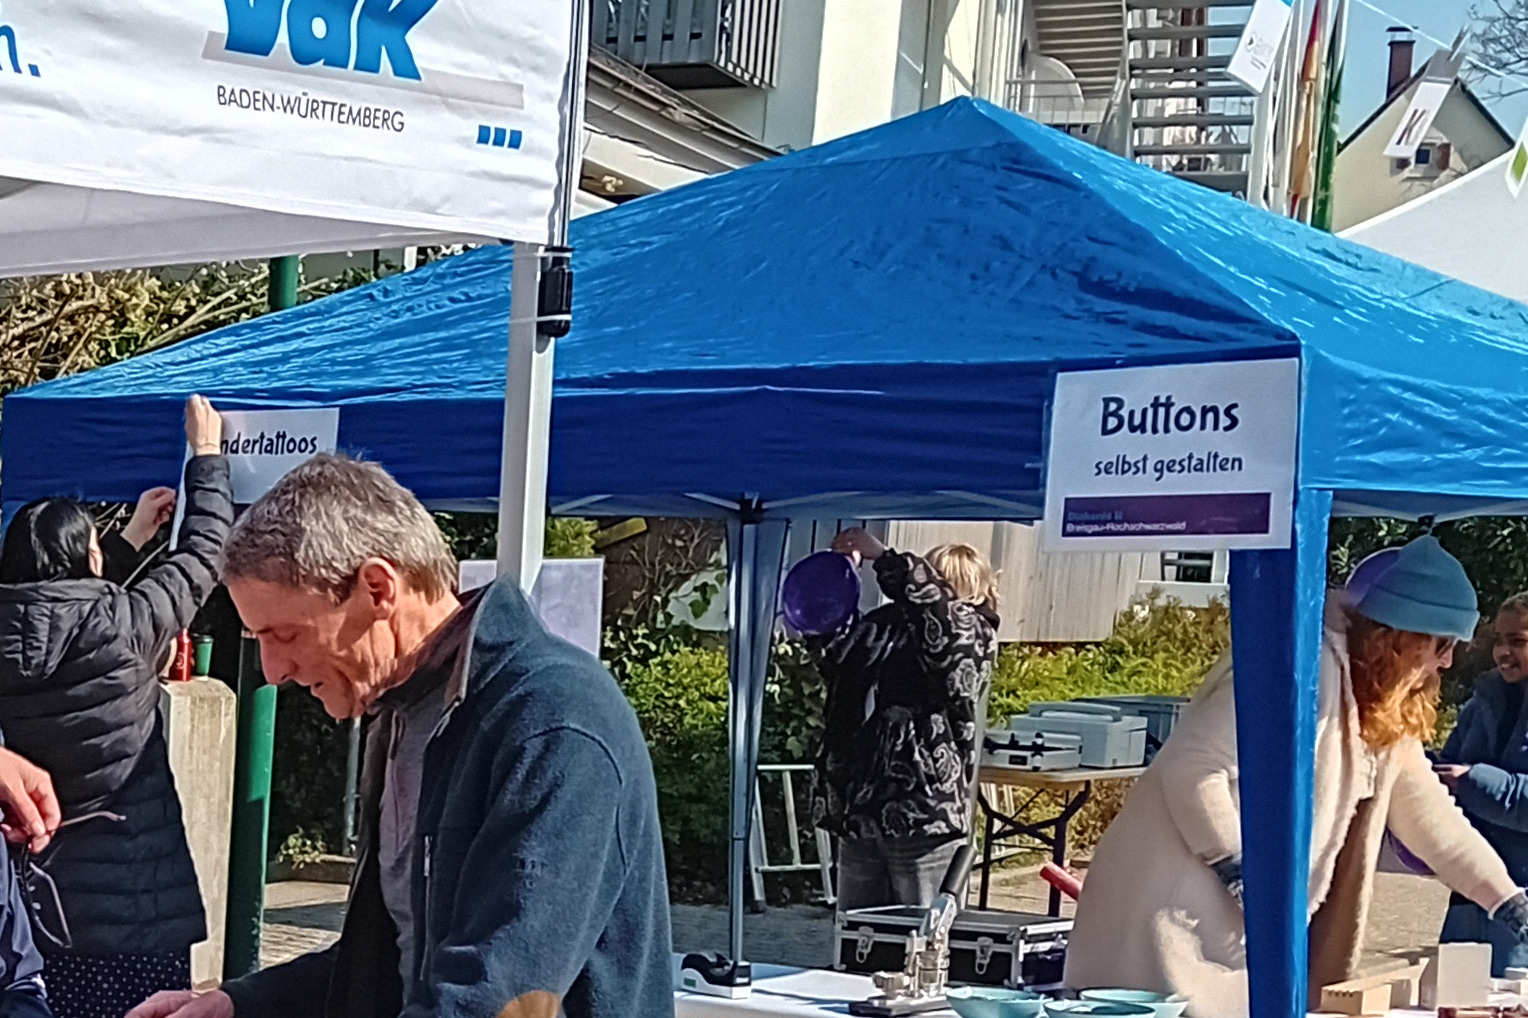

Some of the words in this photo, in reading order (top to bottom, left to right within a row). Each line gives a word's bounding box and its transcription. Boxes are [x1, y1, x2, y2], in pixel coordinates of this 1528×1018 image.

[224, 0, 440, 81] VdK
[217, 85, 405, 133] BADEN-WÜRTTEMBERG
[1101, 395, 1240, 436] Buttons
[220, 431, 317, 455] ndertattoos
[1094, 453, 1149, 477] selbst
[1153, 451, 1243, 482] gestalten
